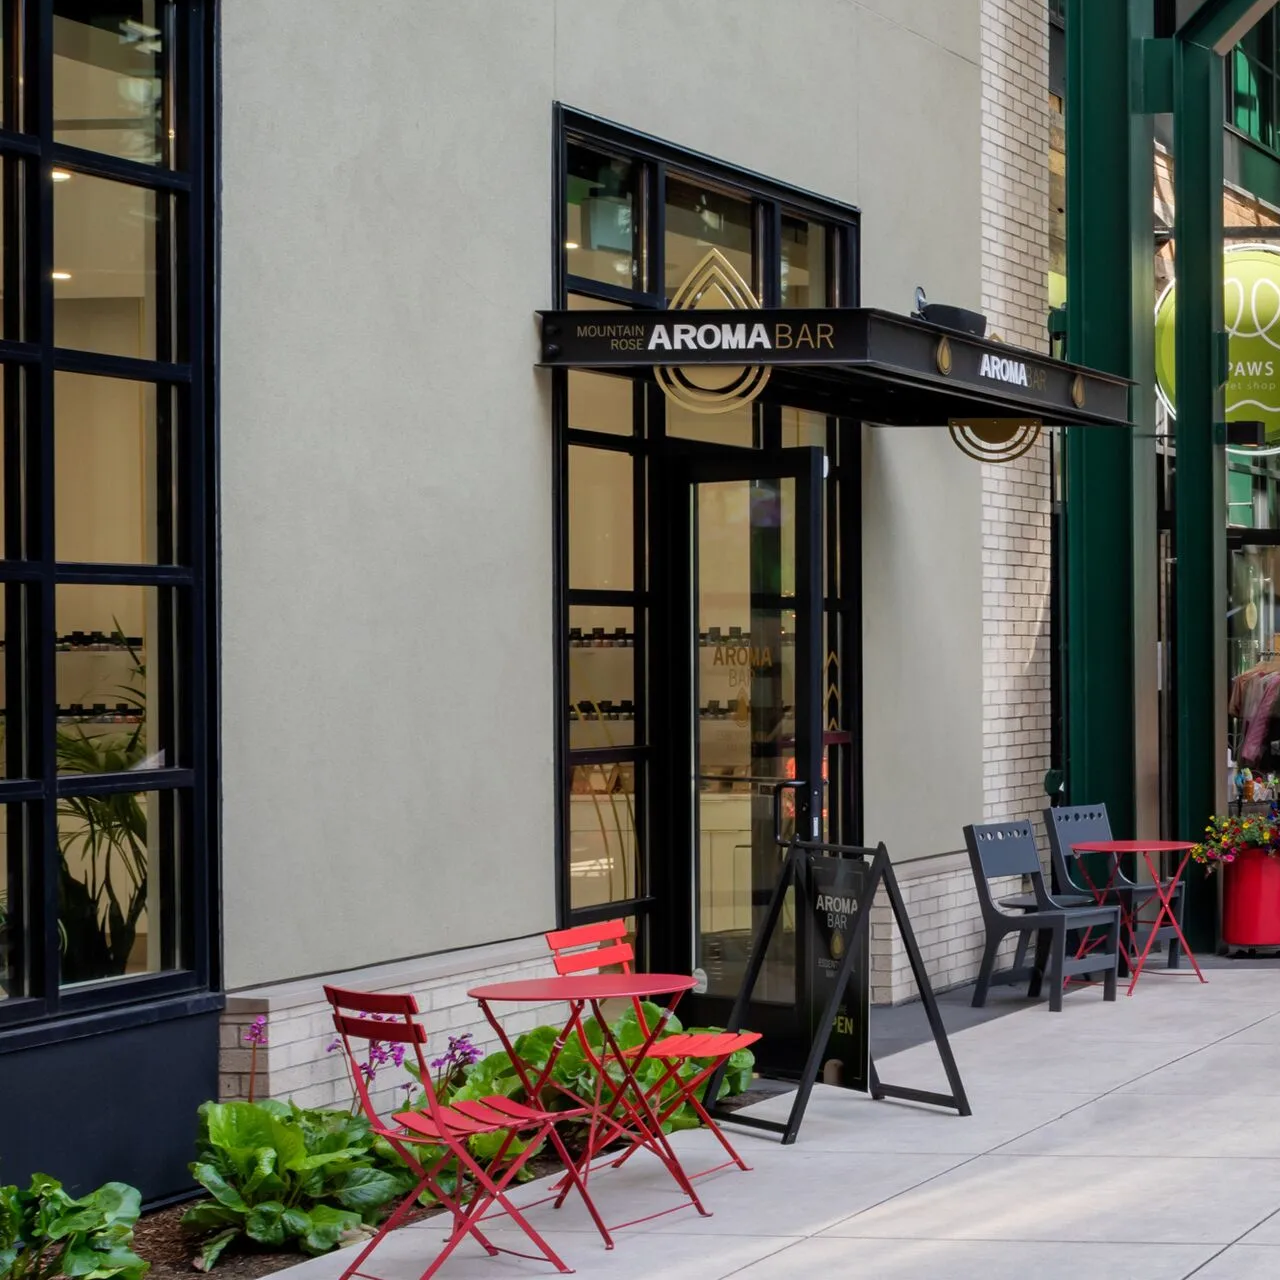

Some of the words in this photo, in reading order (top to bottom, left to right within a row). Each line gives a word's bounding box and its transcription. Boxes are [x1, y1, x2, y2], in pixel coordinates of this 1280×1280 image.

[576, 324, 645, 338] MOUNTAIN
[647, 323, 772, 350] AROMA
[774, 323, 835, 350] BAR
[610, 337, 644, 351] ROSE
[979, 353, 1028, 387] AROMA
[713, 646, 773, 668] AROMA
[816, 894, 858, 915] AROMA
[827, 912, 848, 930] BAR
